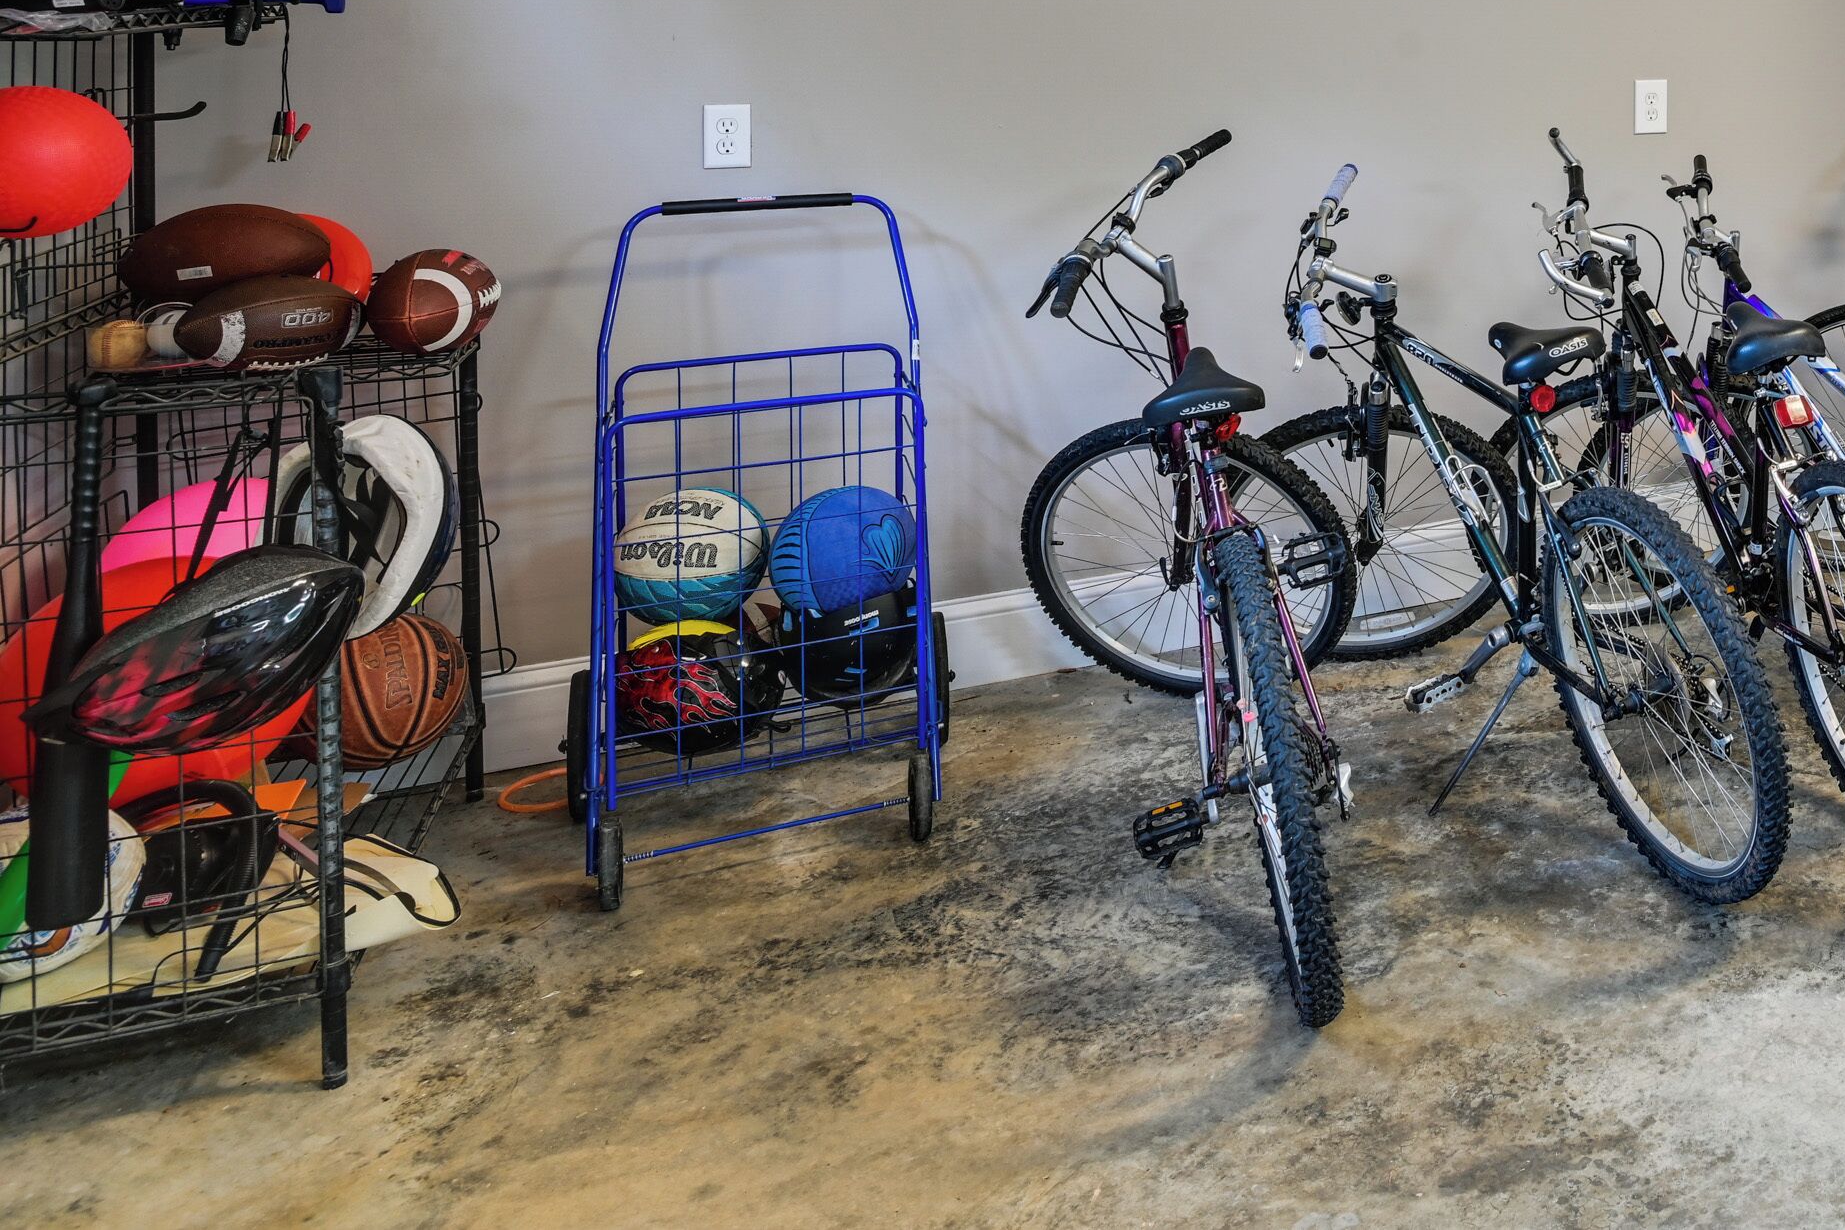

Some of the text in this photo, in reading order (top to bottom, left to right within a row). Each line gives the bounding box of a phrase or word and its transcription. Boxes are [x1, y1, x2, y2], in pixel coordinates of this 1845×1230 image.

[285, 311, 331, 326] 400
[1549, 337, 1588, 357] OASIS
[644, 500, 722, 520] NCAA
[620, 541, 718, 568] Wilson
